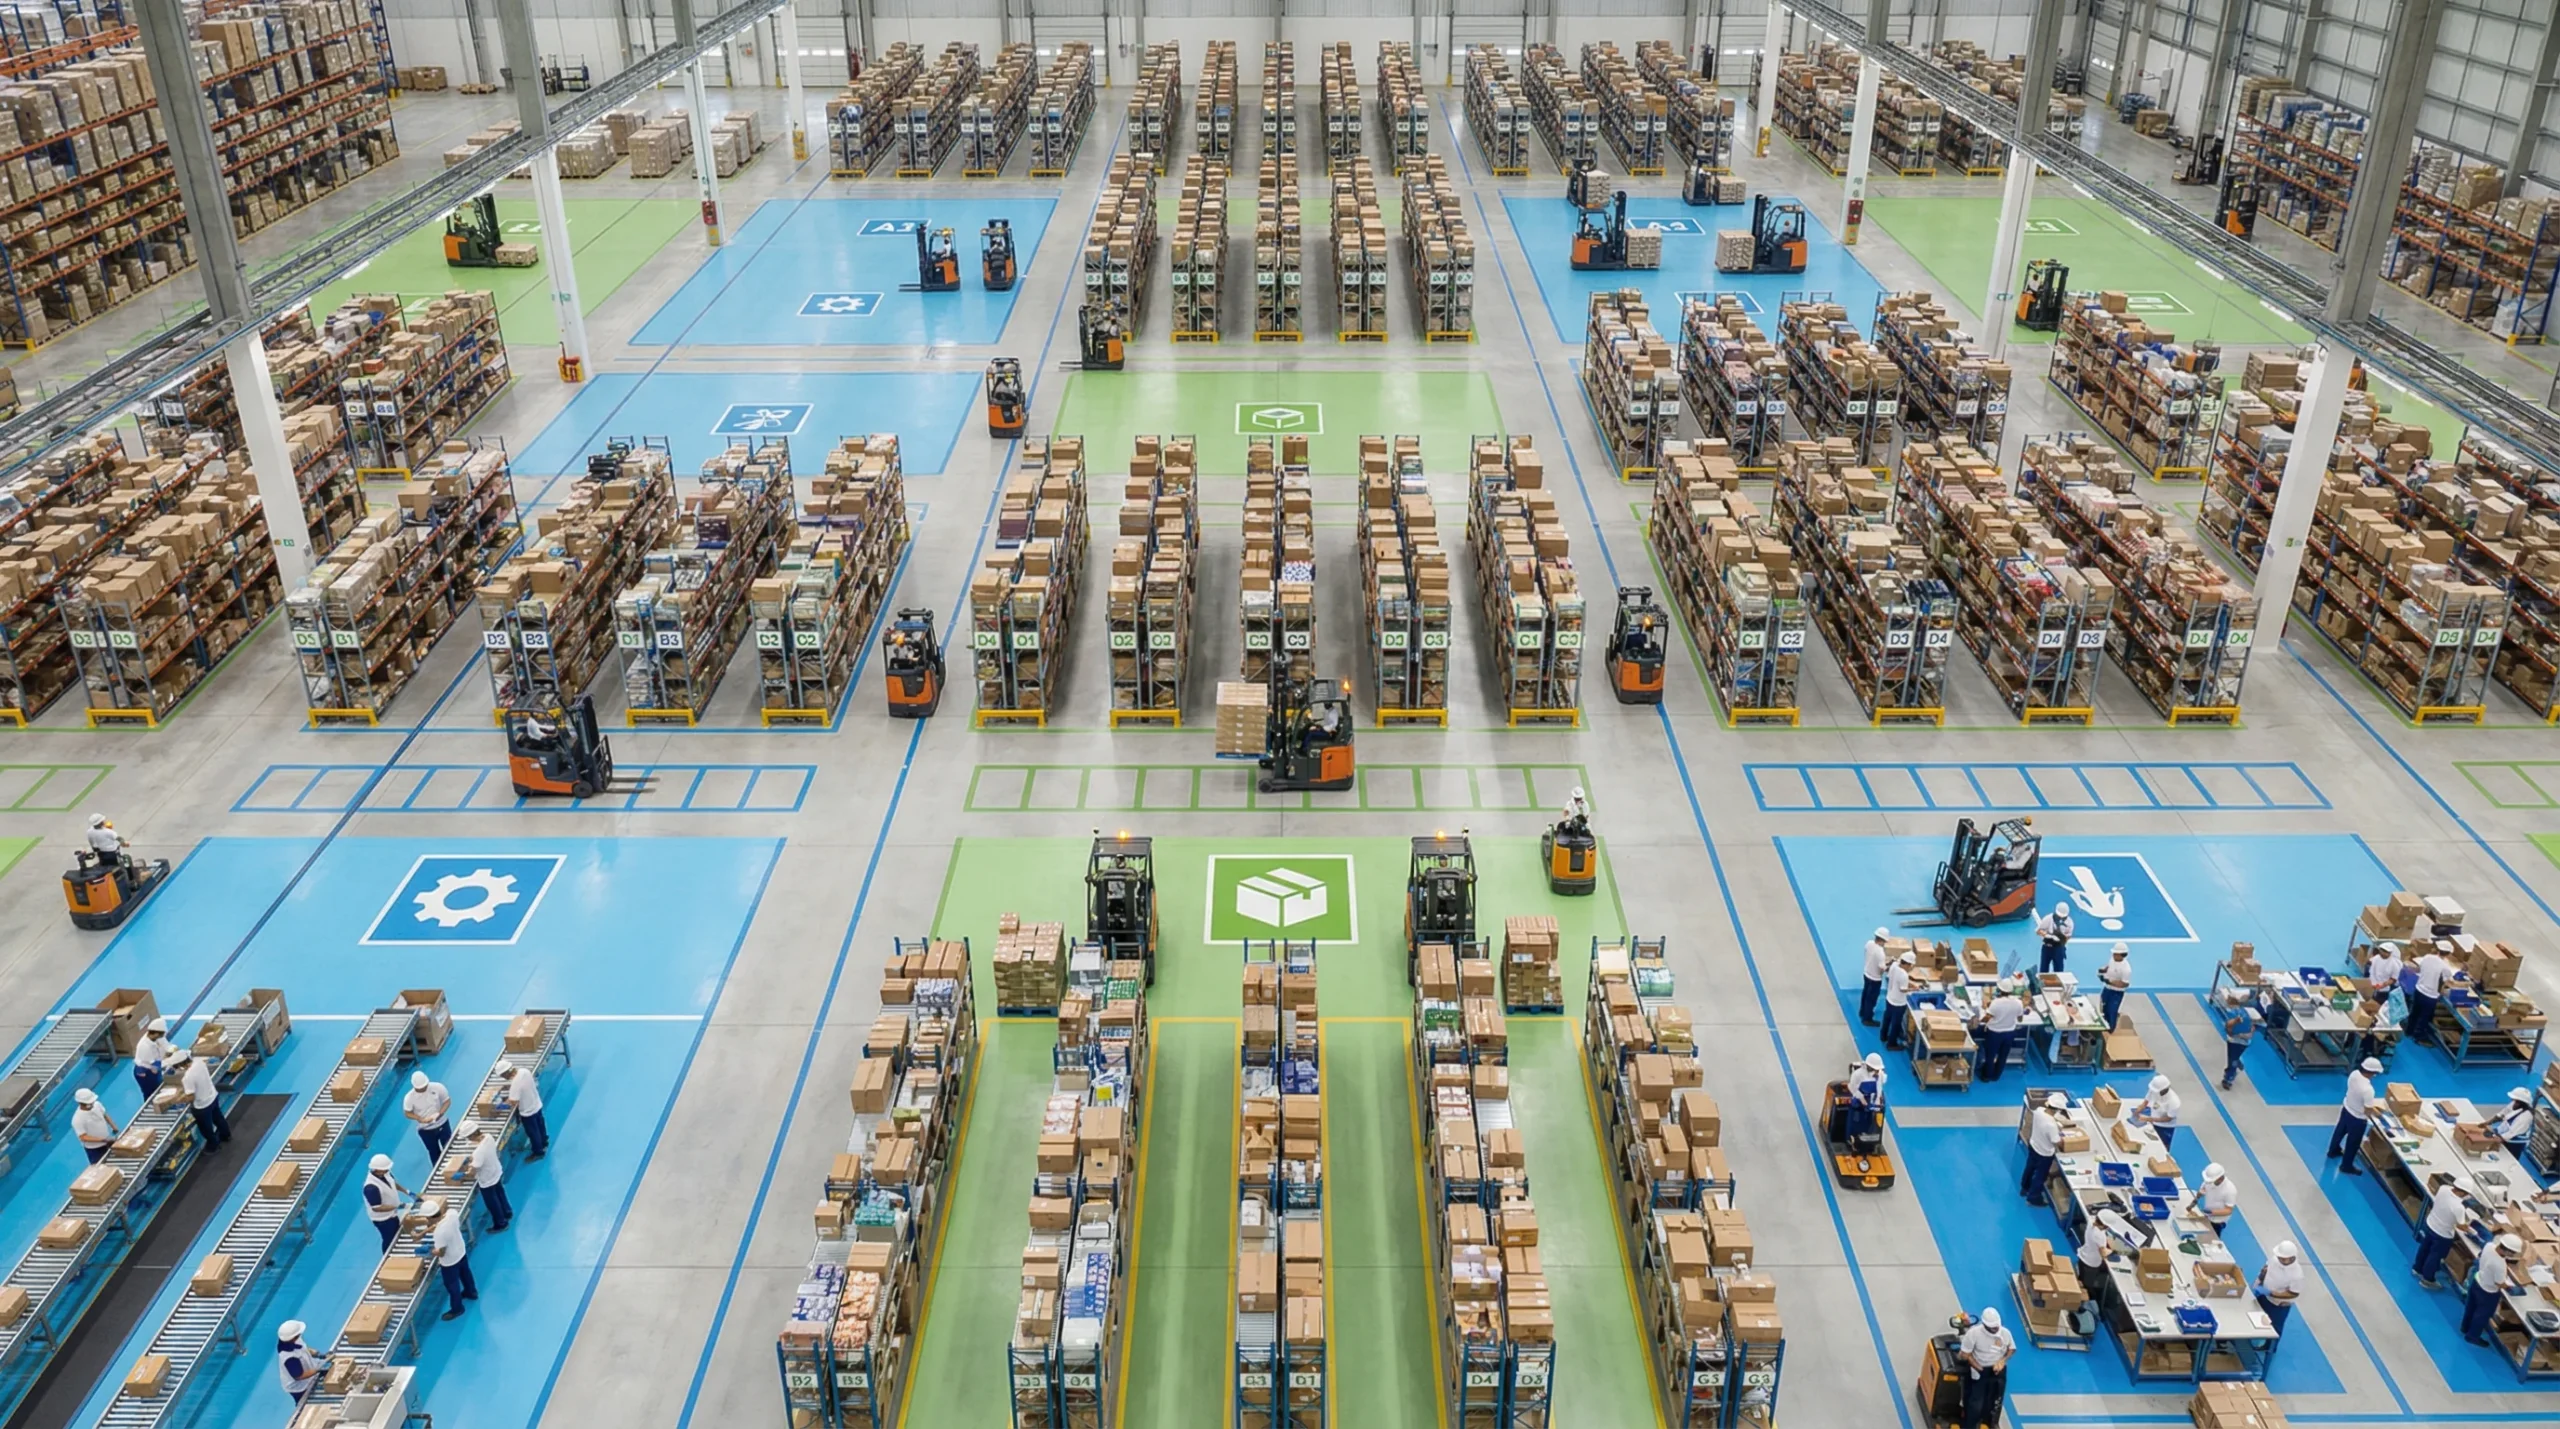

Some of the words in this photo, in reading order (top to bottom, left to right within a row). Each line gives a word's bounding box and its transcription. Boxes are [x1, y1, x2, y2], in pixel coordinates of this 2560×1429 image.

[660, 634, 679, 646] B3
[978, 634, 996, 646] D4
[1742, 633, 1760, 646] C1
[1781, 633, 1801, 645] C2
[1890, 633, 1909, 645] D3
[1929, 633, 1948, 645] D4
[2042, 632, 2061, 645] D4
[2080, 632, 2100, 645] D3
[2477, 631, 2497, 643] D4
